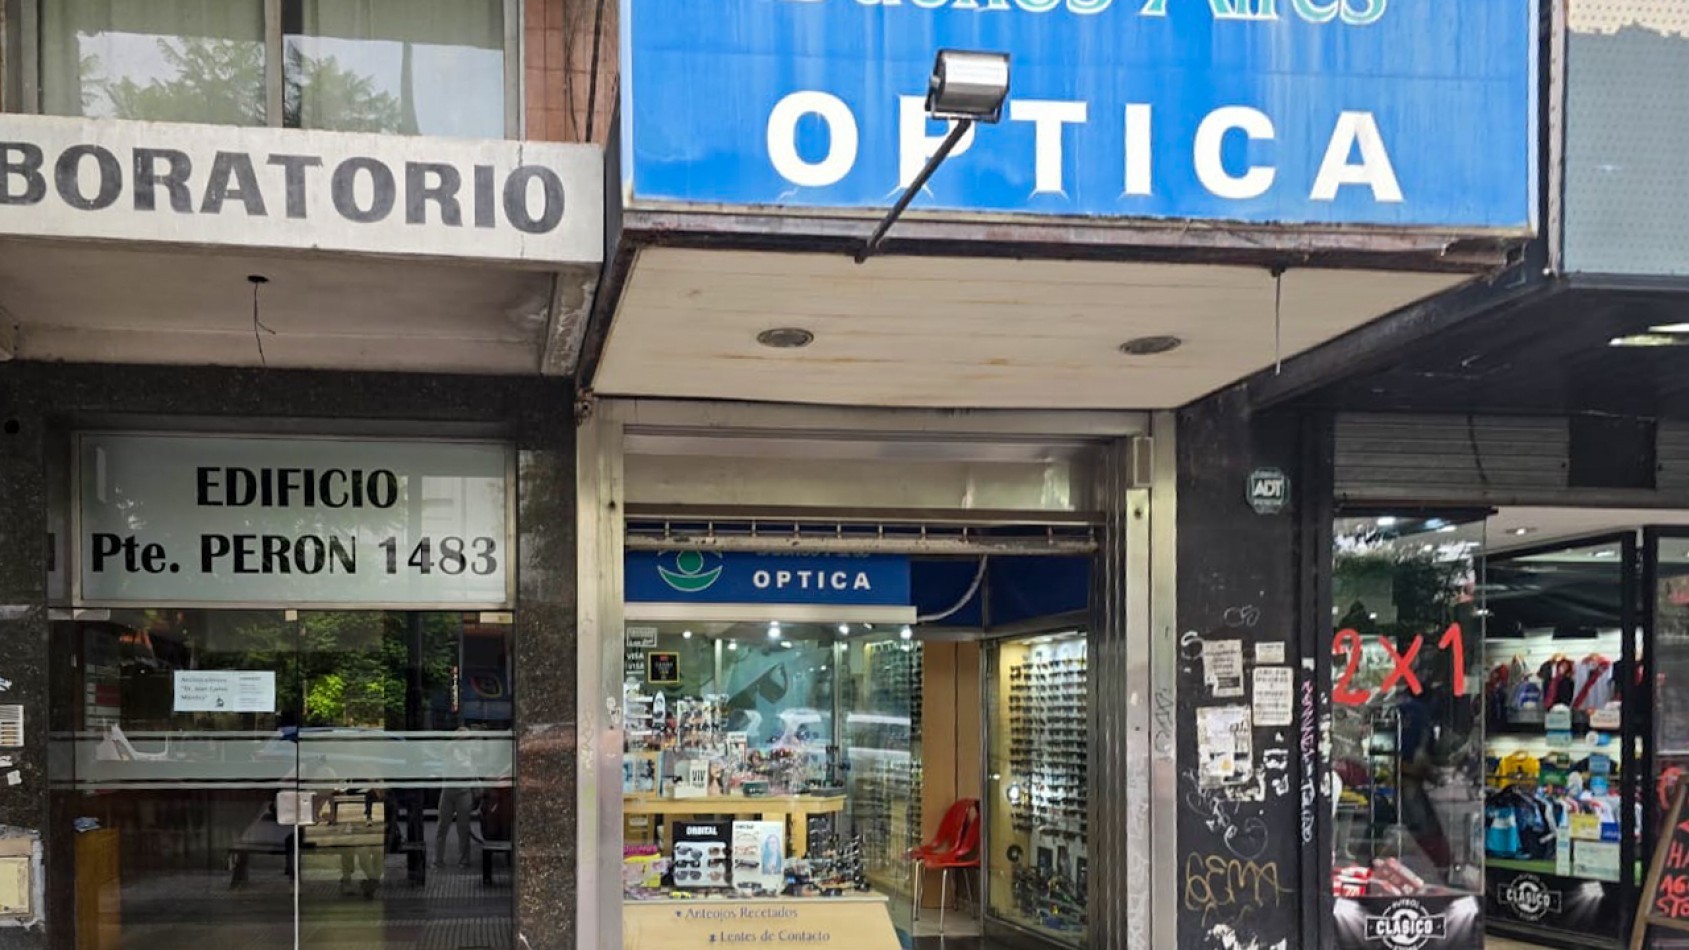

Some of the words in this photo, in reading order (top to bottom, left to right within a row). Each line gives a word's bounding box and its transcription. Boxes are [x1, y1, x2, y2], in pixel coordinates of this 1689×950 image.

[767, 90, 1404, 202] OPTICA
[0, 141, 565, 234] BORATORIO
[196, 466, 397, 508] EDIFICIO
[1252, 479, 1281, 497] ADT
[91, 532, 180, 574] Pte.
[200, 533, 356, 574] PERON
[378, 535, 498, 575] 1483
[752, 569, 871, 590] OPTICA
[685, 907, 736, 921] Anteojos
[740, 906, 798, 919] Recetados
[720, 930, 756, 942] Lentes
[760, 930, 775, 941] de
[779, 930, 830, 943] Contacto
[1376, 919, 1434, 935] CLASICO
